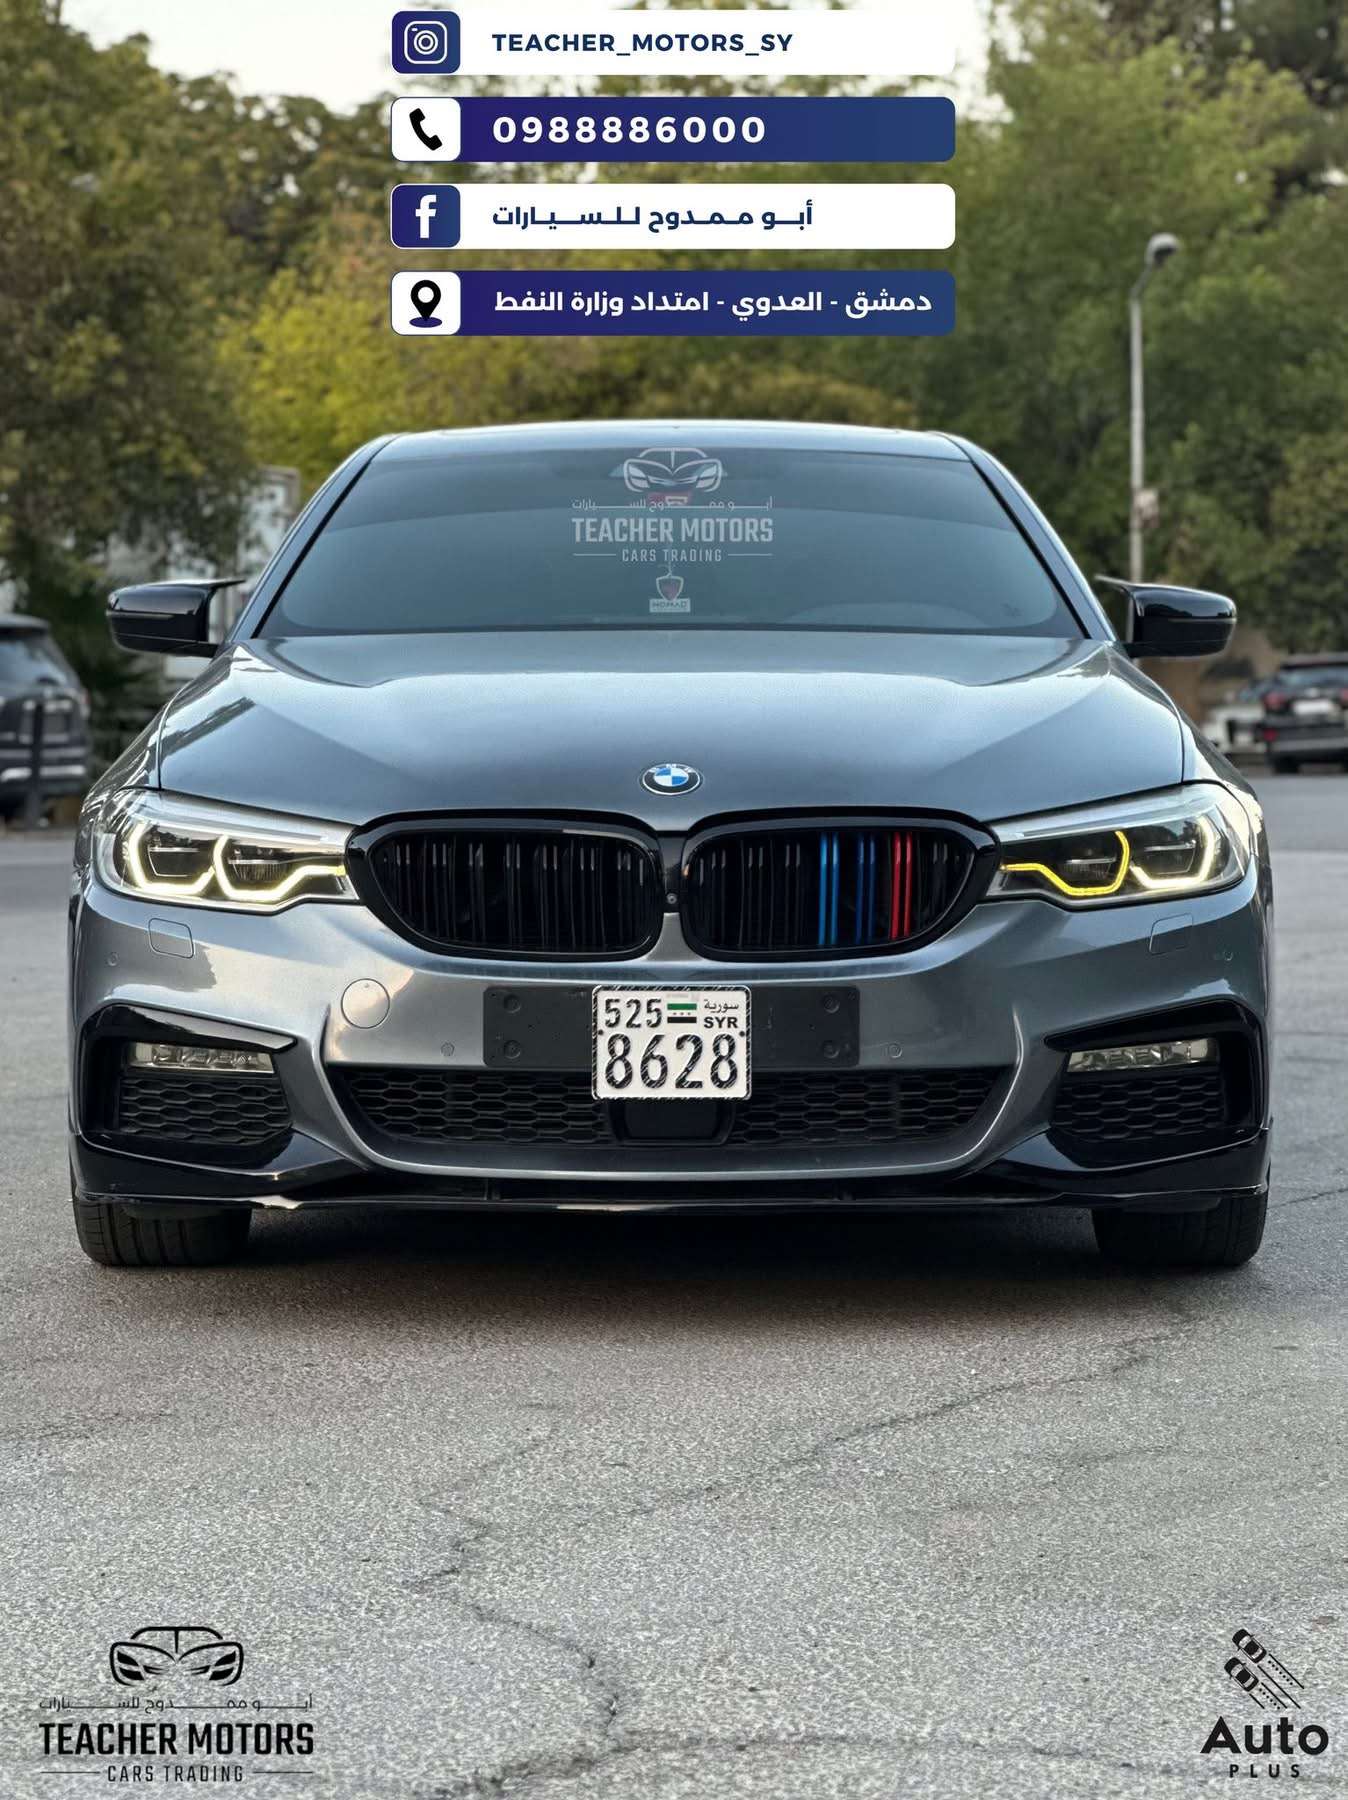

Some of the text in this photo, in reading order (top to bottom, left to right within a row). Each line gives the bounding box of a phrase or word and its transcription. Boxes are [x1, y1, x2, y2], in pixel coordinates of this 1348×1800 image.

[605, 998, 662, 1028] 525
[703, 998, 740, 1013] سورية
[703, 1016, 739, 1029] SYR
[605, 1033, 738, 1089] 8628
